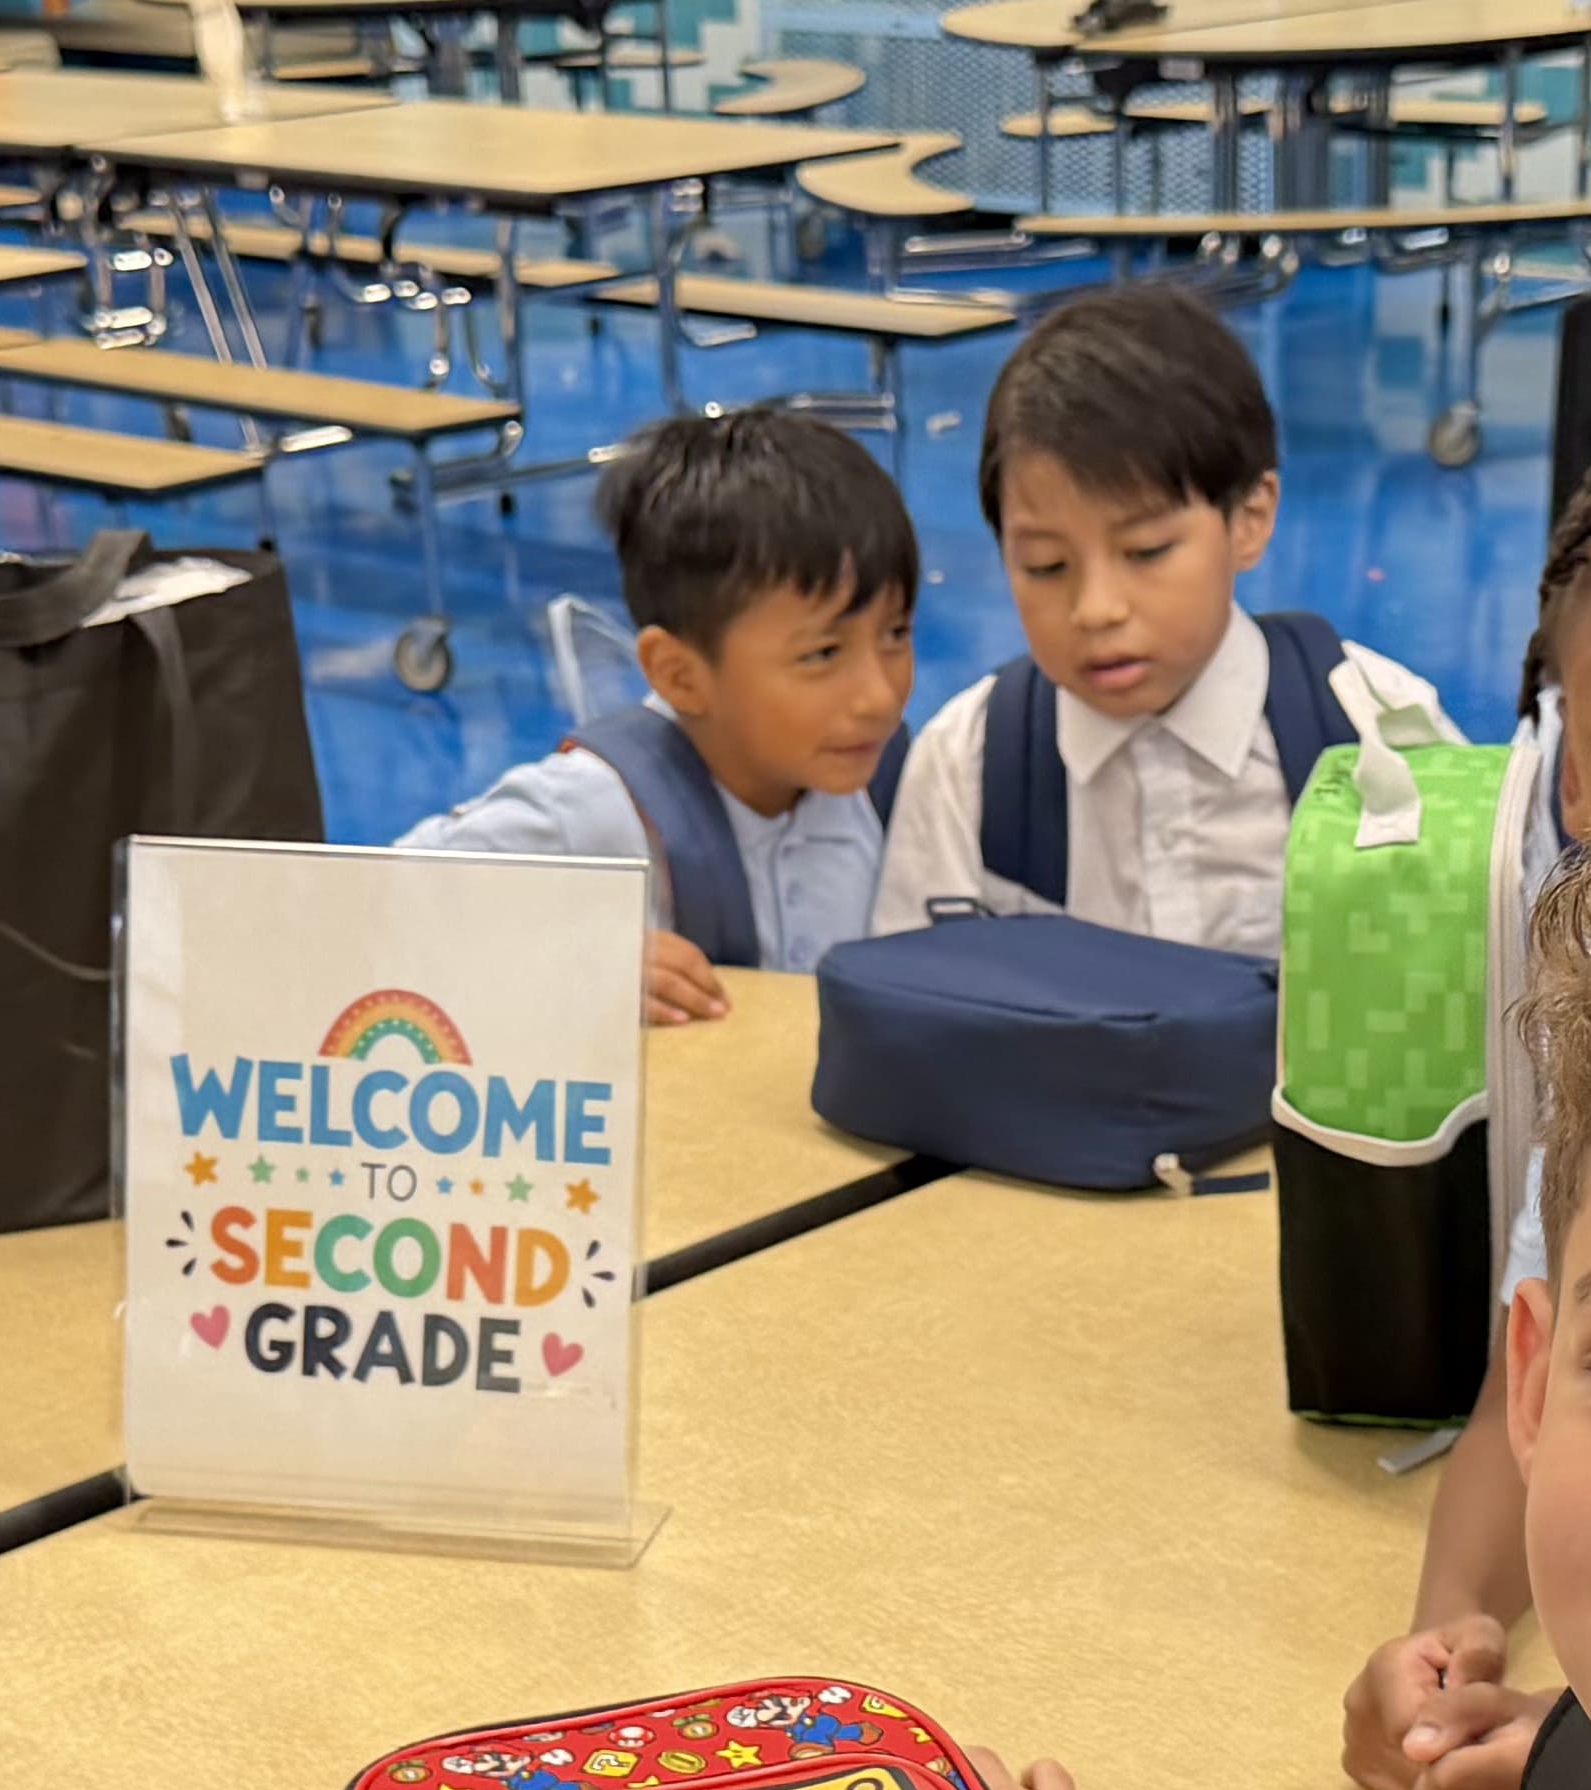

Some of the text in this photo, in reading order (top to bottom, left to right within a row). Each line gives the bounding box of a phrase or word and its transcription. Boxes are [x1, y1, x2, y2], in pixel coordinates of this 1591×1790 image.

[170, 1053, 613, 1166] WELCOME
[361, 1162, 418, 1203] TO
[210, 1205, 571, 1309] SECOND
[244, 1302, 522, 1395] GRADE
